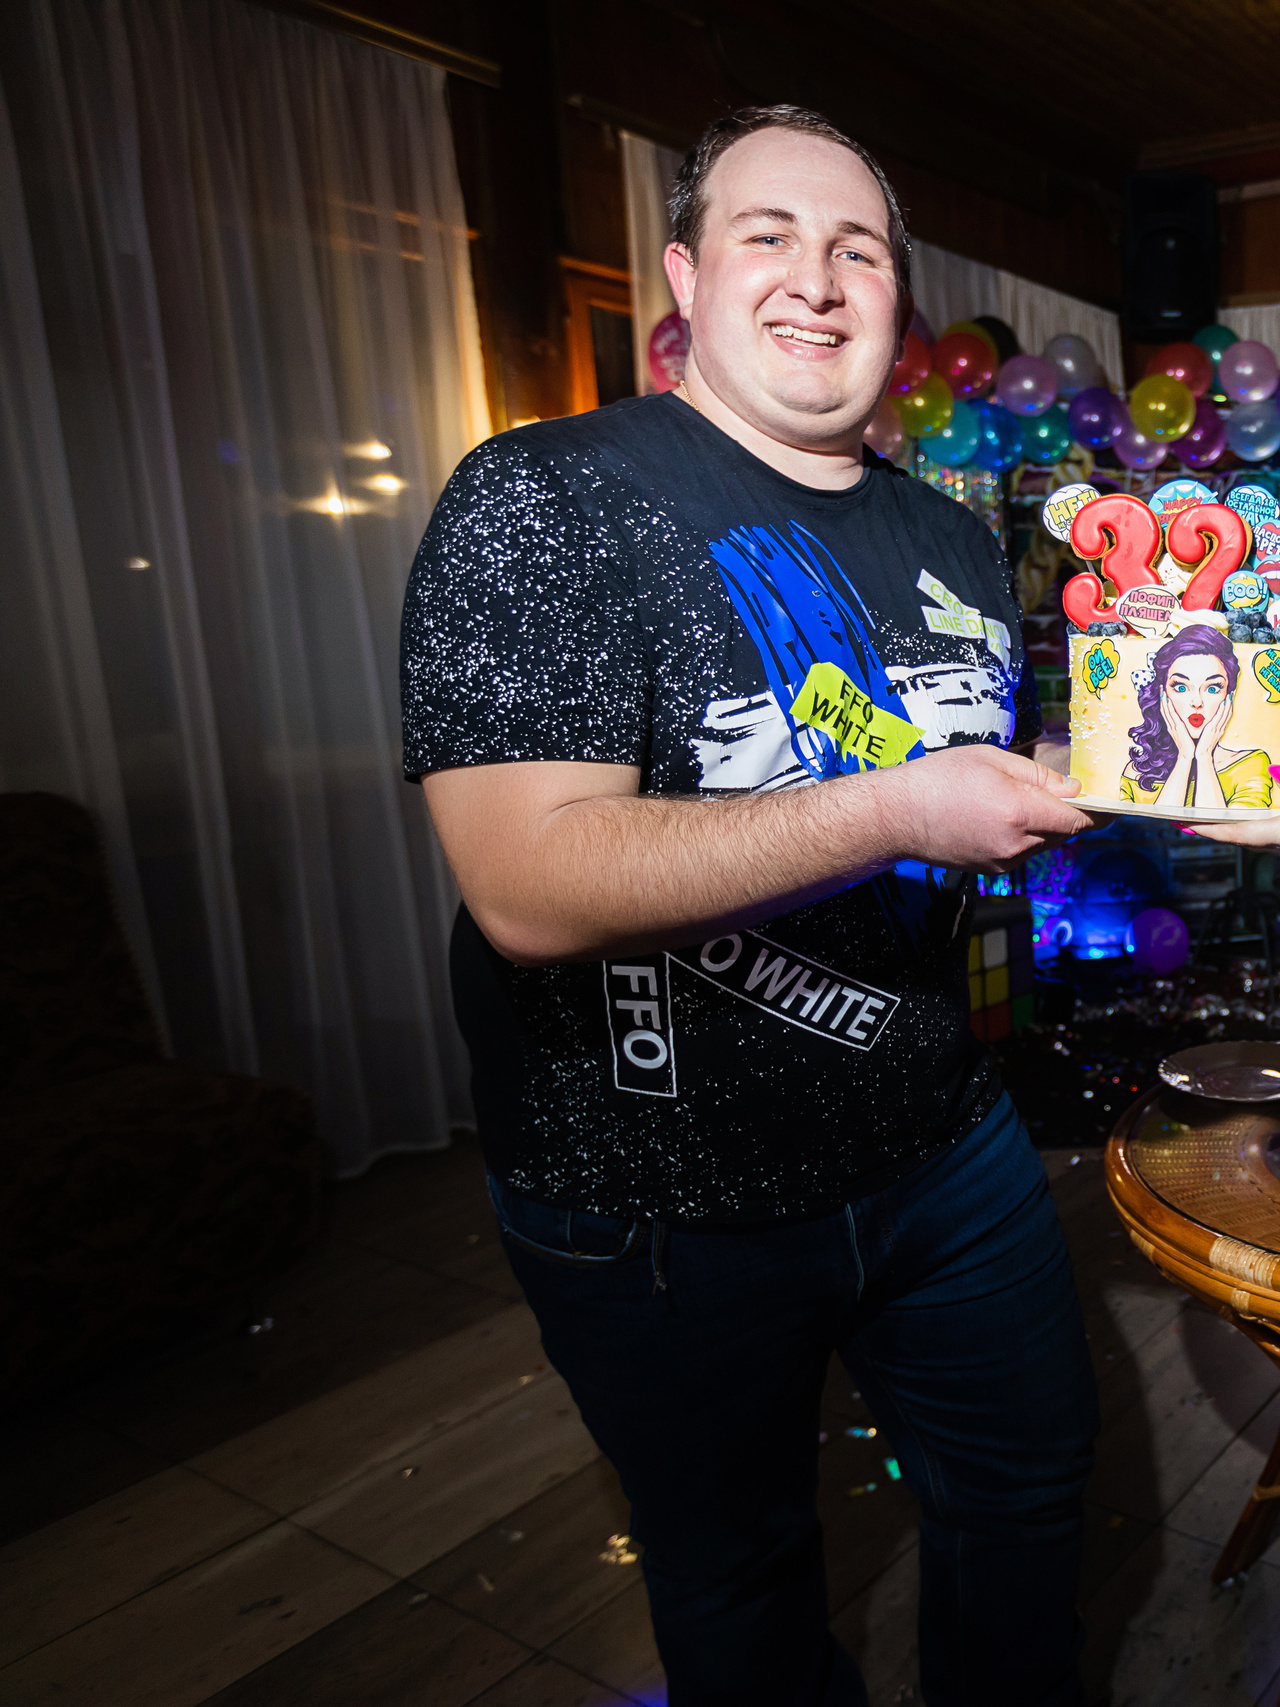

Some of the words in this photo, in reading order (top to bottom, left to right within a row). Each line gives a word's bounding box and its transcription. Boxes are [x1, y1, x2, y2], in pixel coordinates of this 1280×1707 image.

[1163, 497, 1202, 511] HAPPY
[1227, 500, 1276, 517] ОСТАЛЬНОЕ
[1230, 490, 1262, 505] ВСЕГДА
[1264, 498, 1277, 508] 18!
[1063, 493, 1252, 634] 32
[1129, 590, 1175, 609] ПОФИГ!
[1224, 578, 1268, 602] BOO!!
[928, 611, 965, 633] LINE
[1088, 648, 1105, 670] ОЙ
[1266, 648, 1277, 661] НЕ
[1090, 656, 1114, 689] ВСЕ!
[1259, 666, 1270, 679] НЕ
[839, 679, 874, 724] FFO
[811, 691, 886, 759] WHITE
[744, 947, 887, 1041] WHITE
[611, 964, 668, 1069] FFO
